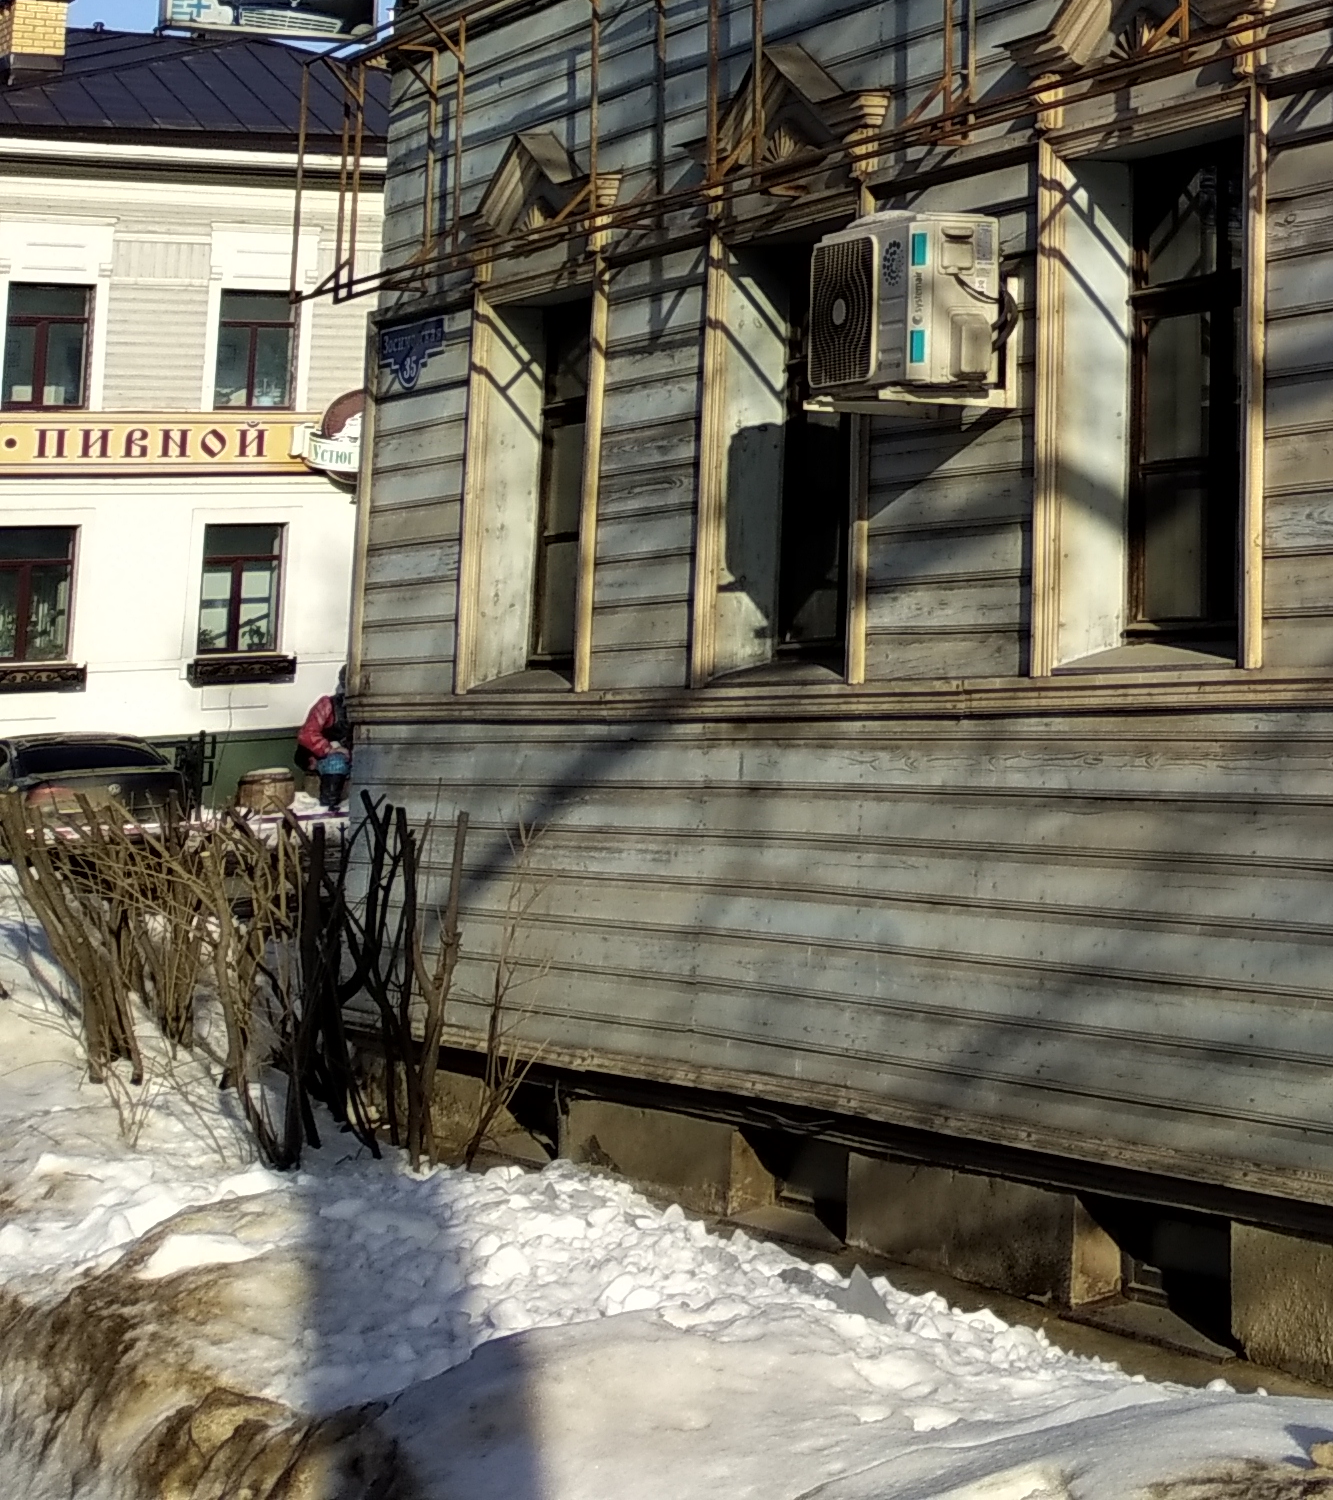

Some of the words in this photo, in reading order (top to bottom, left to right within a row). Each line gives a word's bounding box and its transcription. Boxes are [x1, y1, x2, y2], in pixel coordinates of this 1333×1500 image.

[914, 271, 924, 313] systemair
[382, 327, 442, 354] Зосимская
[403, 355, 417, 379] 35
[32, 421, 270, 460] ПИВНОЙ
